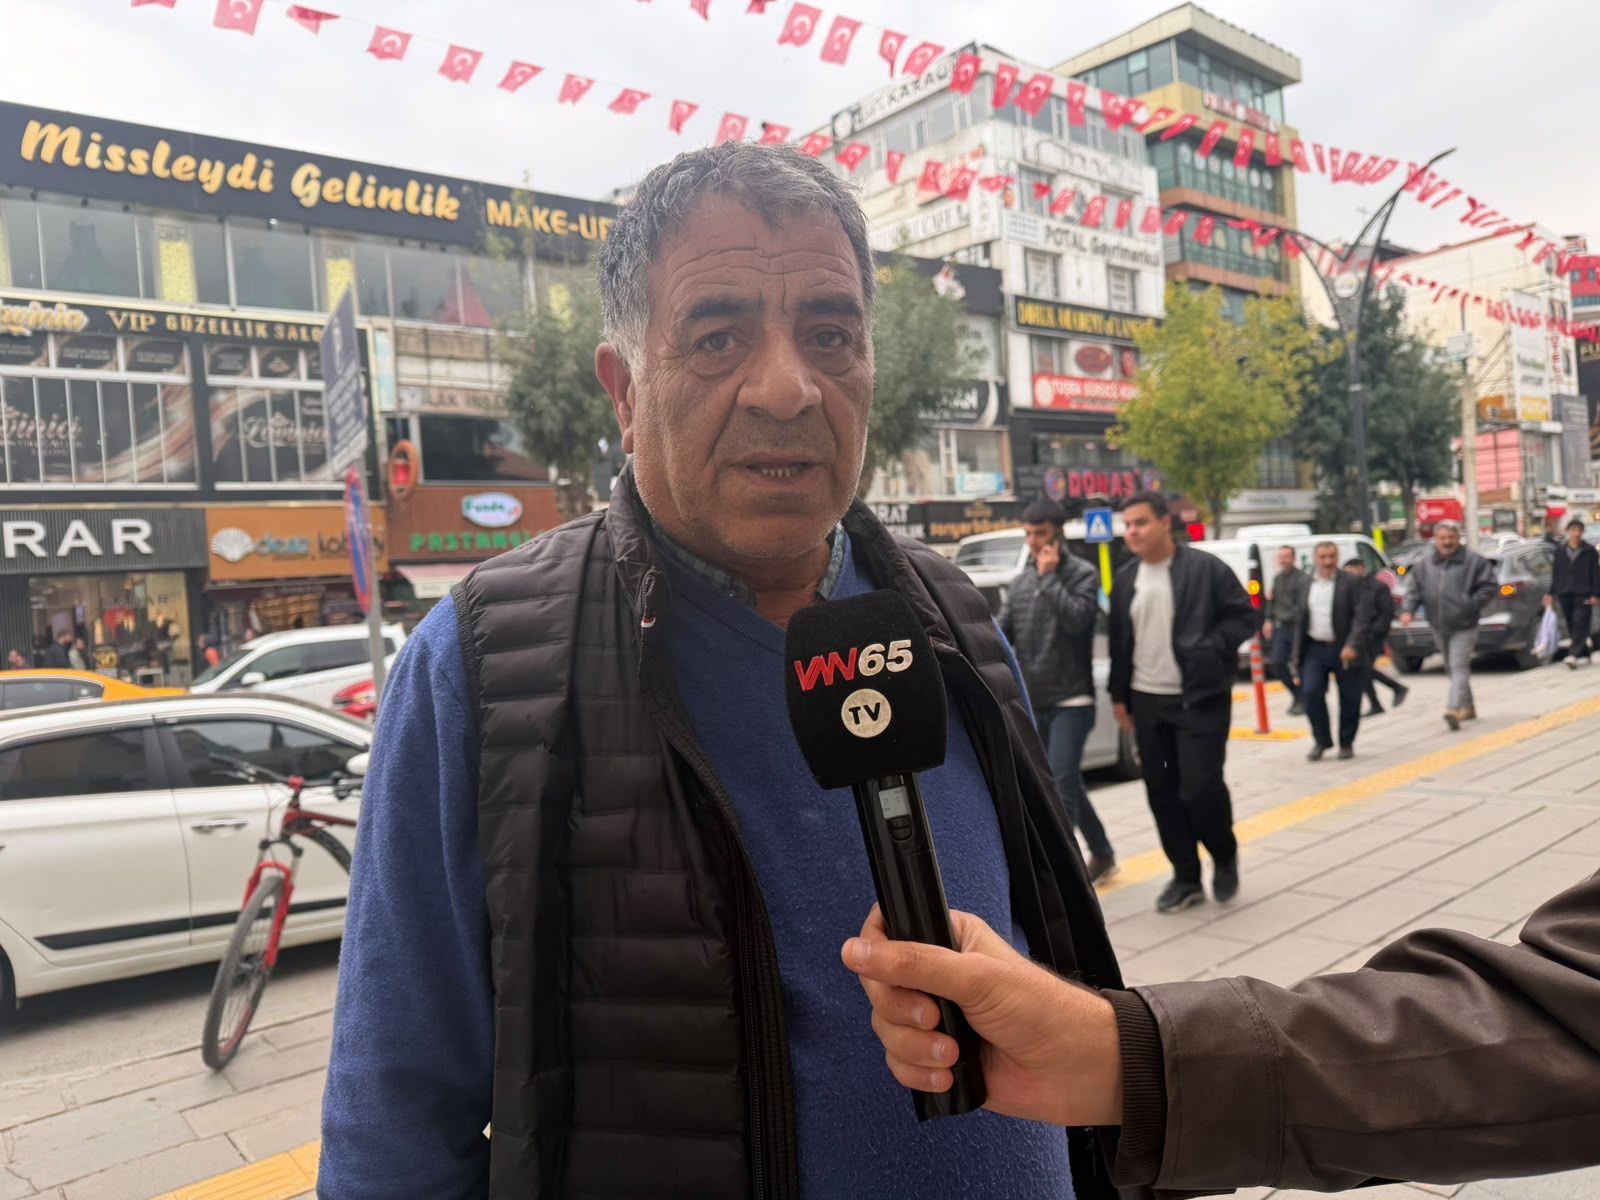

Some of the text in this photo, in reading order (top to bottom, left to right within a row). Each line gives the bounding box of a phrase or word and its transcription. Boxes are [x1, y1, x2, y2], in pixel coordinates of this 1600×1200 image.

[20, 119, 275, 194] Missleydi
[290, 162, 460, 221] Gelinlik
[107, 310, 157, 333] VIP
[2, 518, 153, 558] RAR
[849, 702, 881, 725] TV
